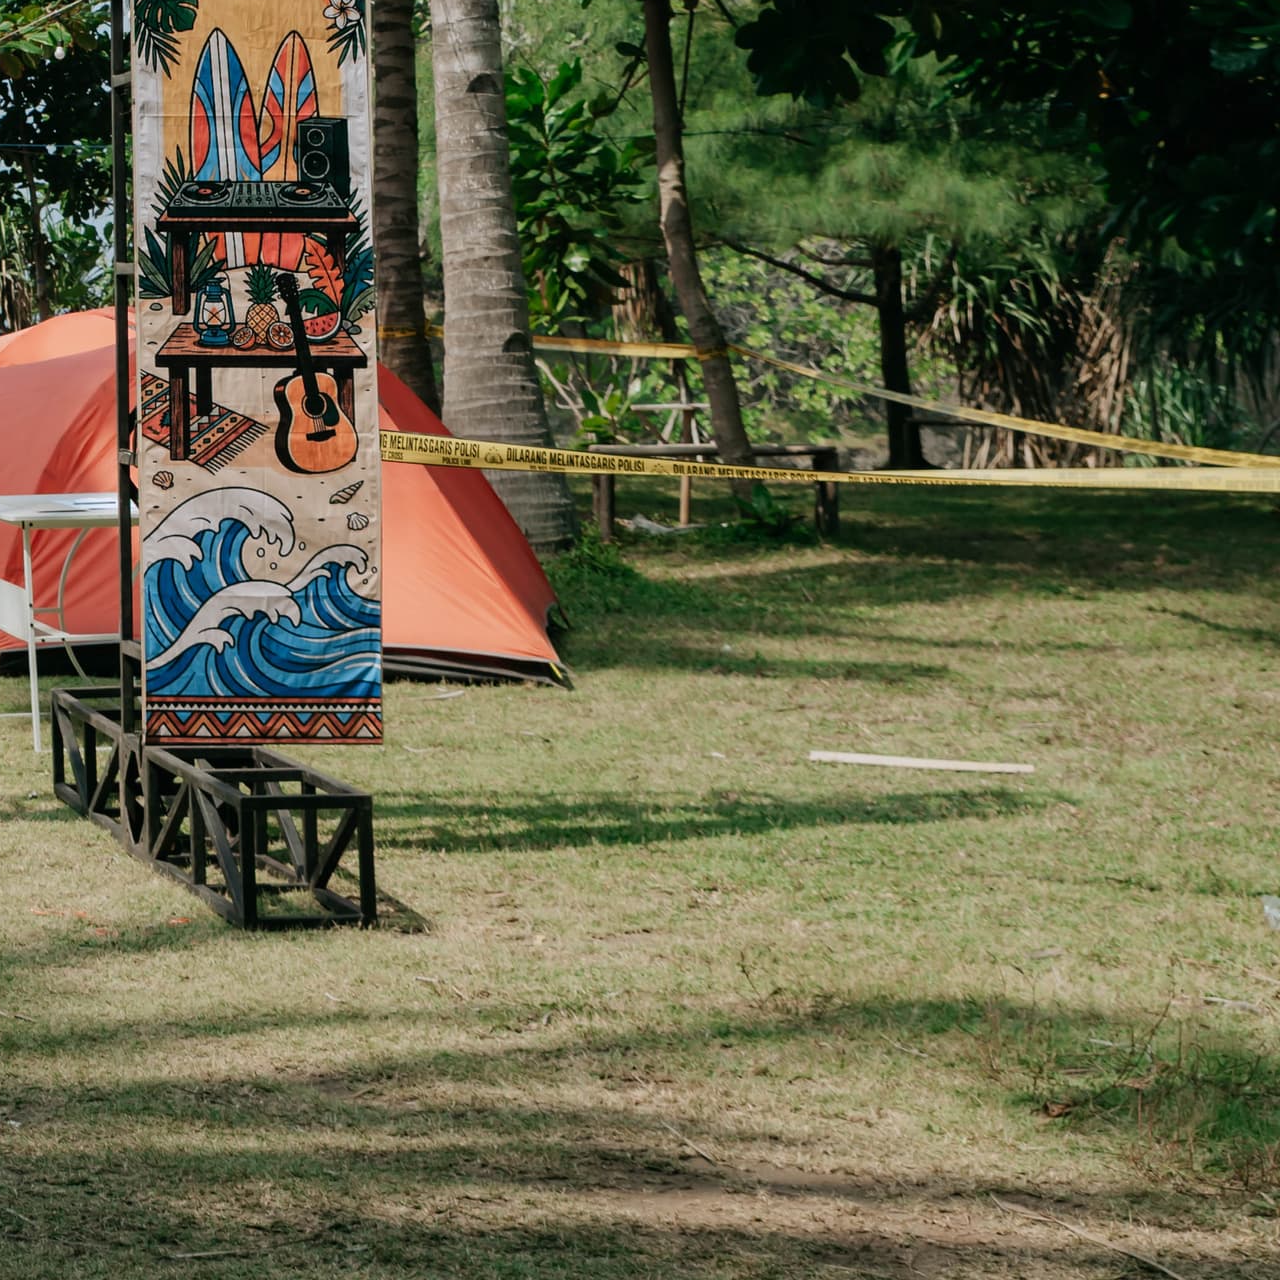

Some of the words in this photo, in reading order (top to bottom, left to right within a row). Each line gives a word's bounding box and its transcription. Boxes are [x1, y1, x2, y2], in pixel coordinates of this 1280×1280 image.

[454, 442, 480, 459] POLISI
[506, 447, 547, 464] DILARANG
[617, 458, 645, 472] POLISI
